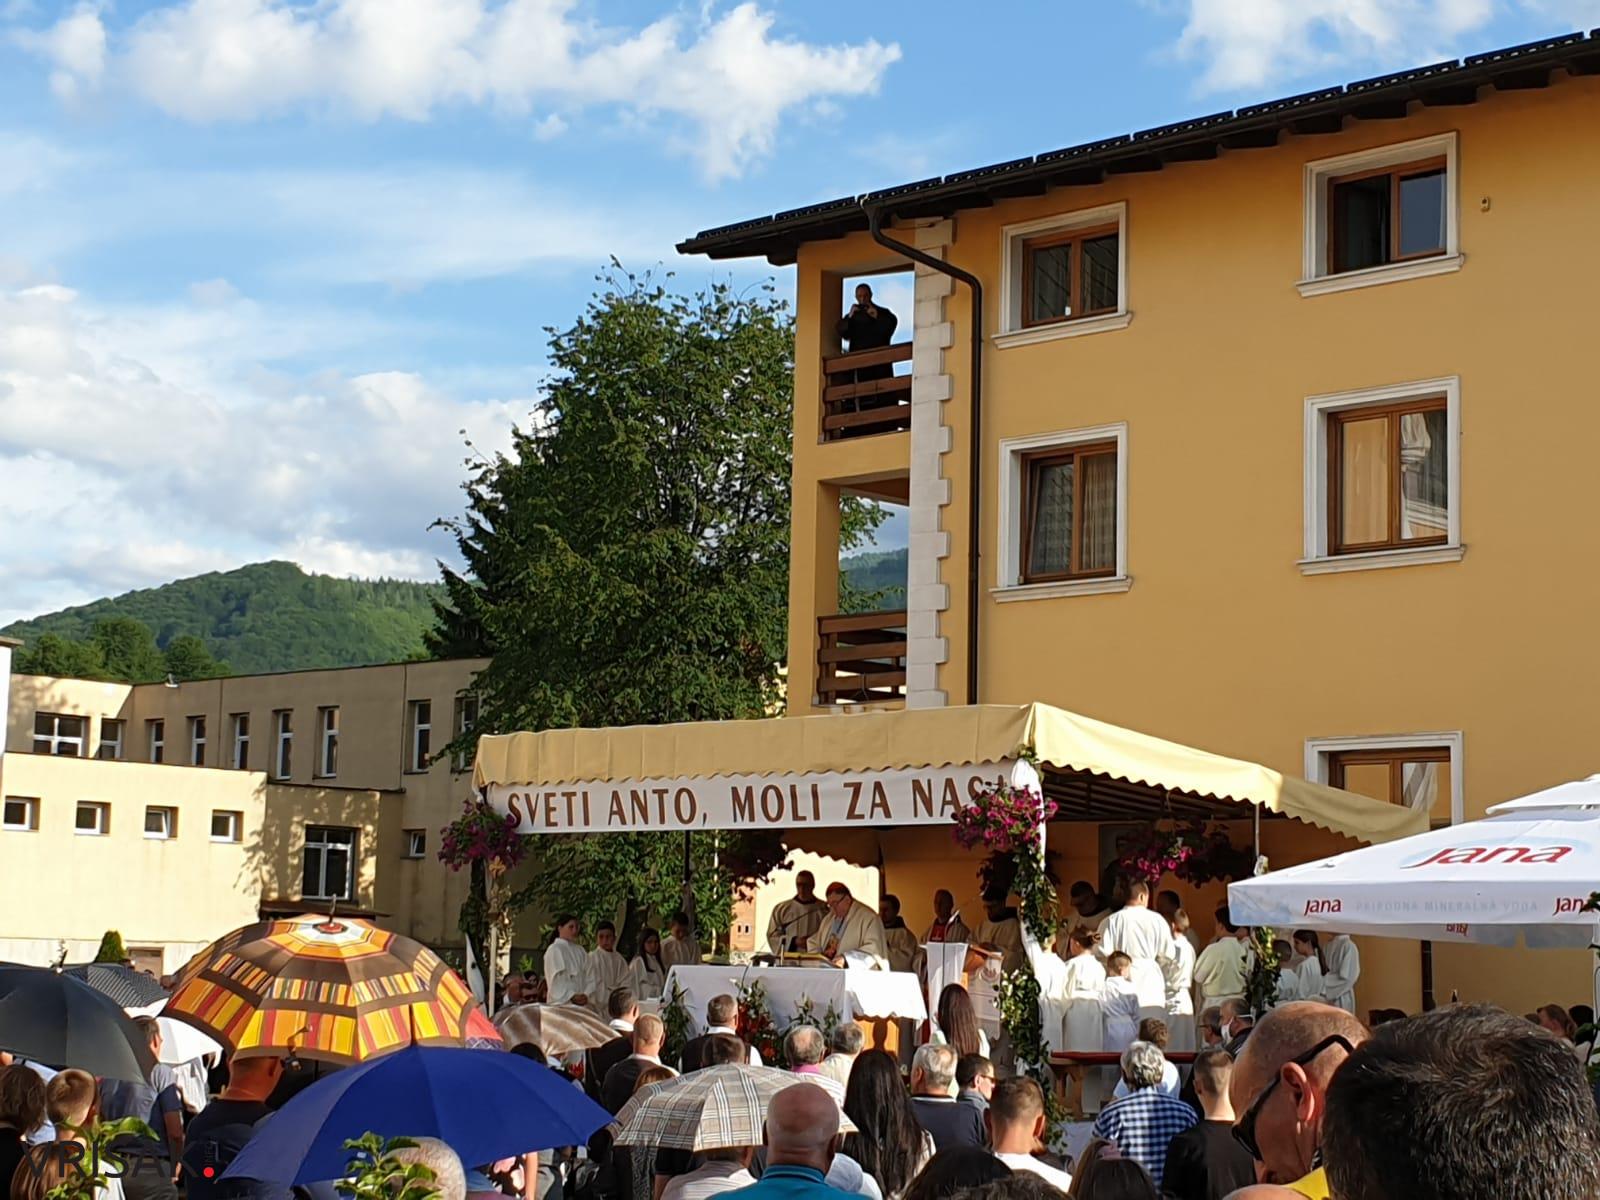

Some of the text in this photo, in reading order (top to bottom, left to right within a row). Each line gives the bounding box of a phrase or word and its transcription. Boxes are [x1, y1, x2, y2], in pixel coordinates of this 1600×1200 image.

[507, 790, 591, 828] SVETI
[608, 787, 709, 826] ANTO,
[731, 783, 822, 823] MOLI
[844, 780, 893, 820] ZA
